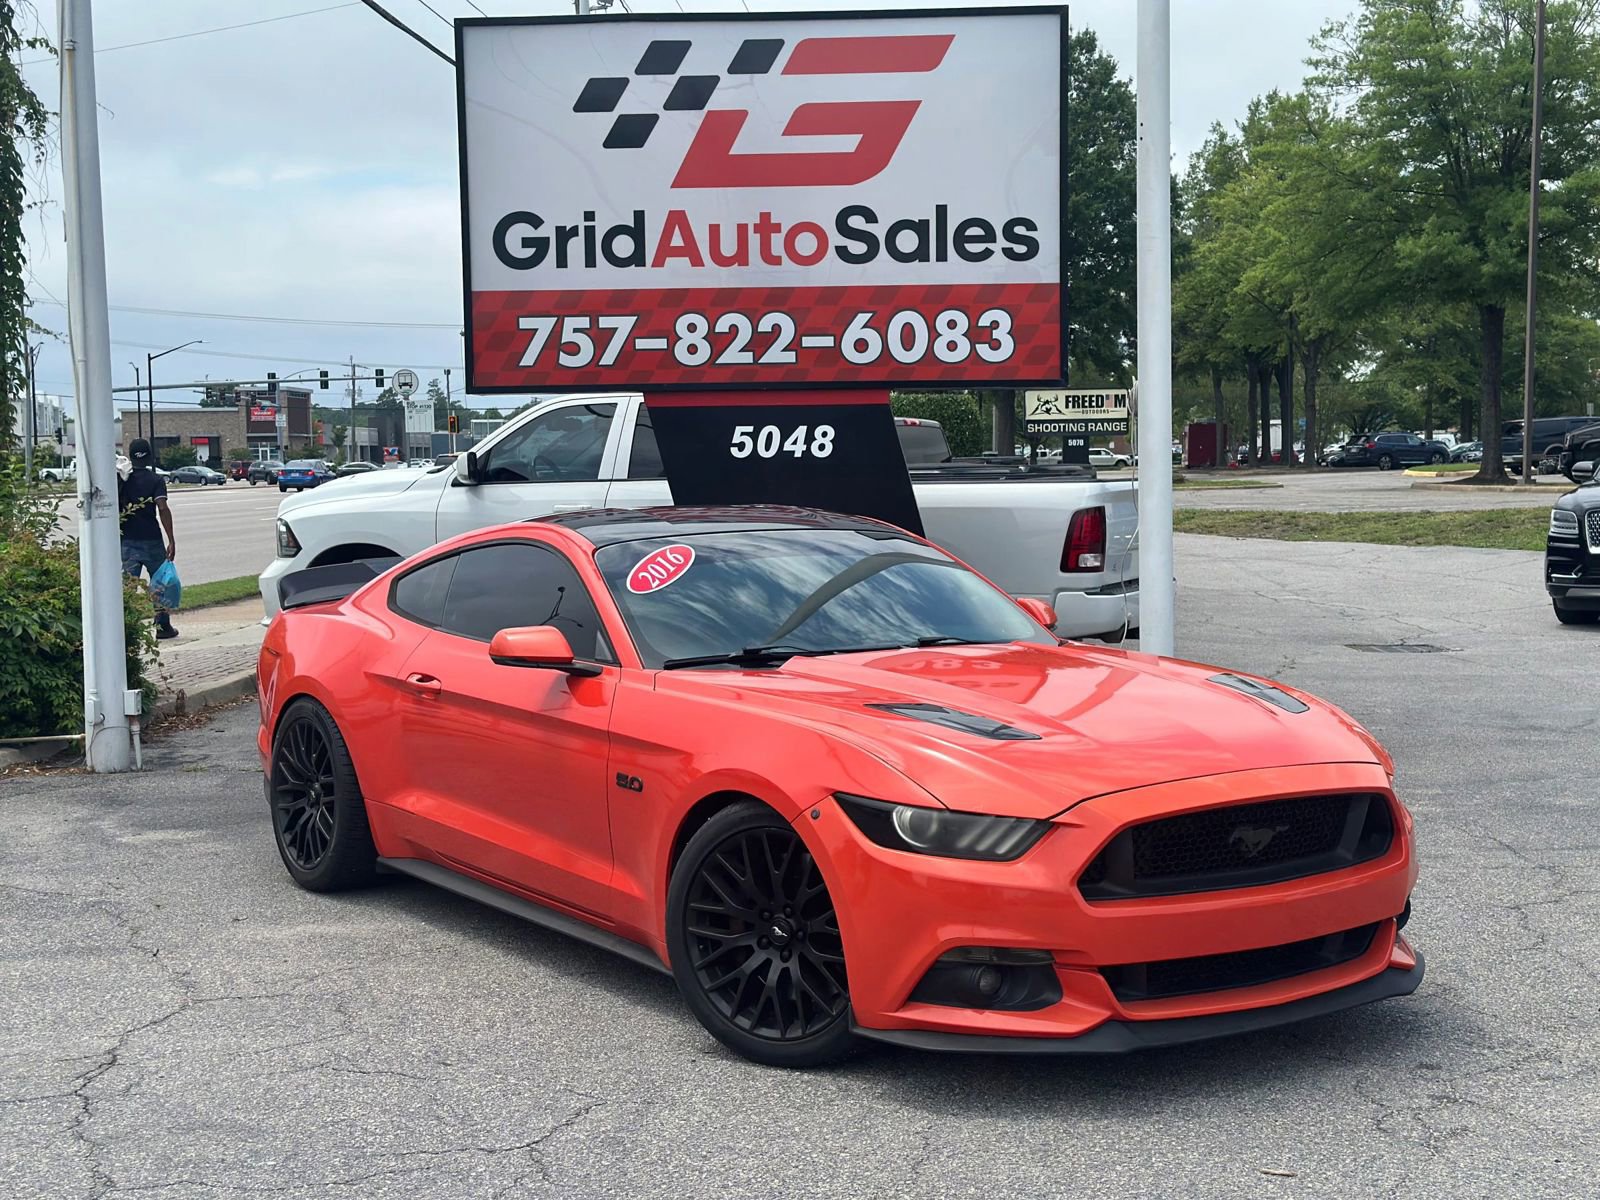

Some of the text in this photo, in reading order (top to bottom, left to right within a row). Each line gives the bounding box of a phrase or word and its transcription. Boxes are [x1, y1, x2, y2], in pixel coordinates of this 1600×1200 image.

[516, 308, 1017, 369] 757-822-6083
[730, 424, 836, 459] 5048
[1027, 421, 1127, 433] SHOOTING RANGE
[638, 548, 685, 589] 2016
